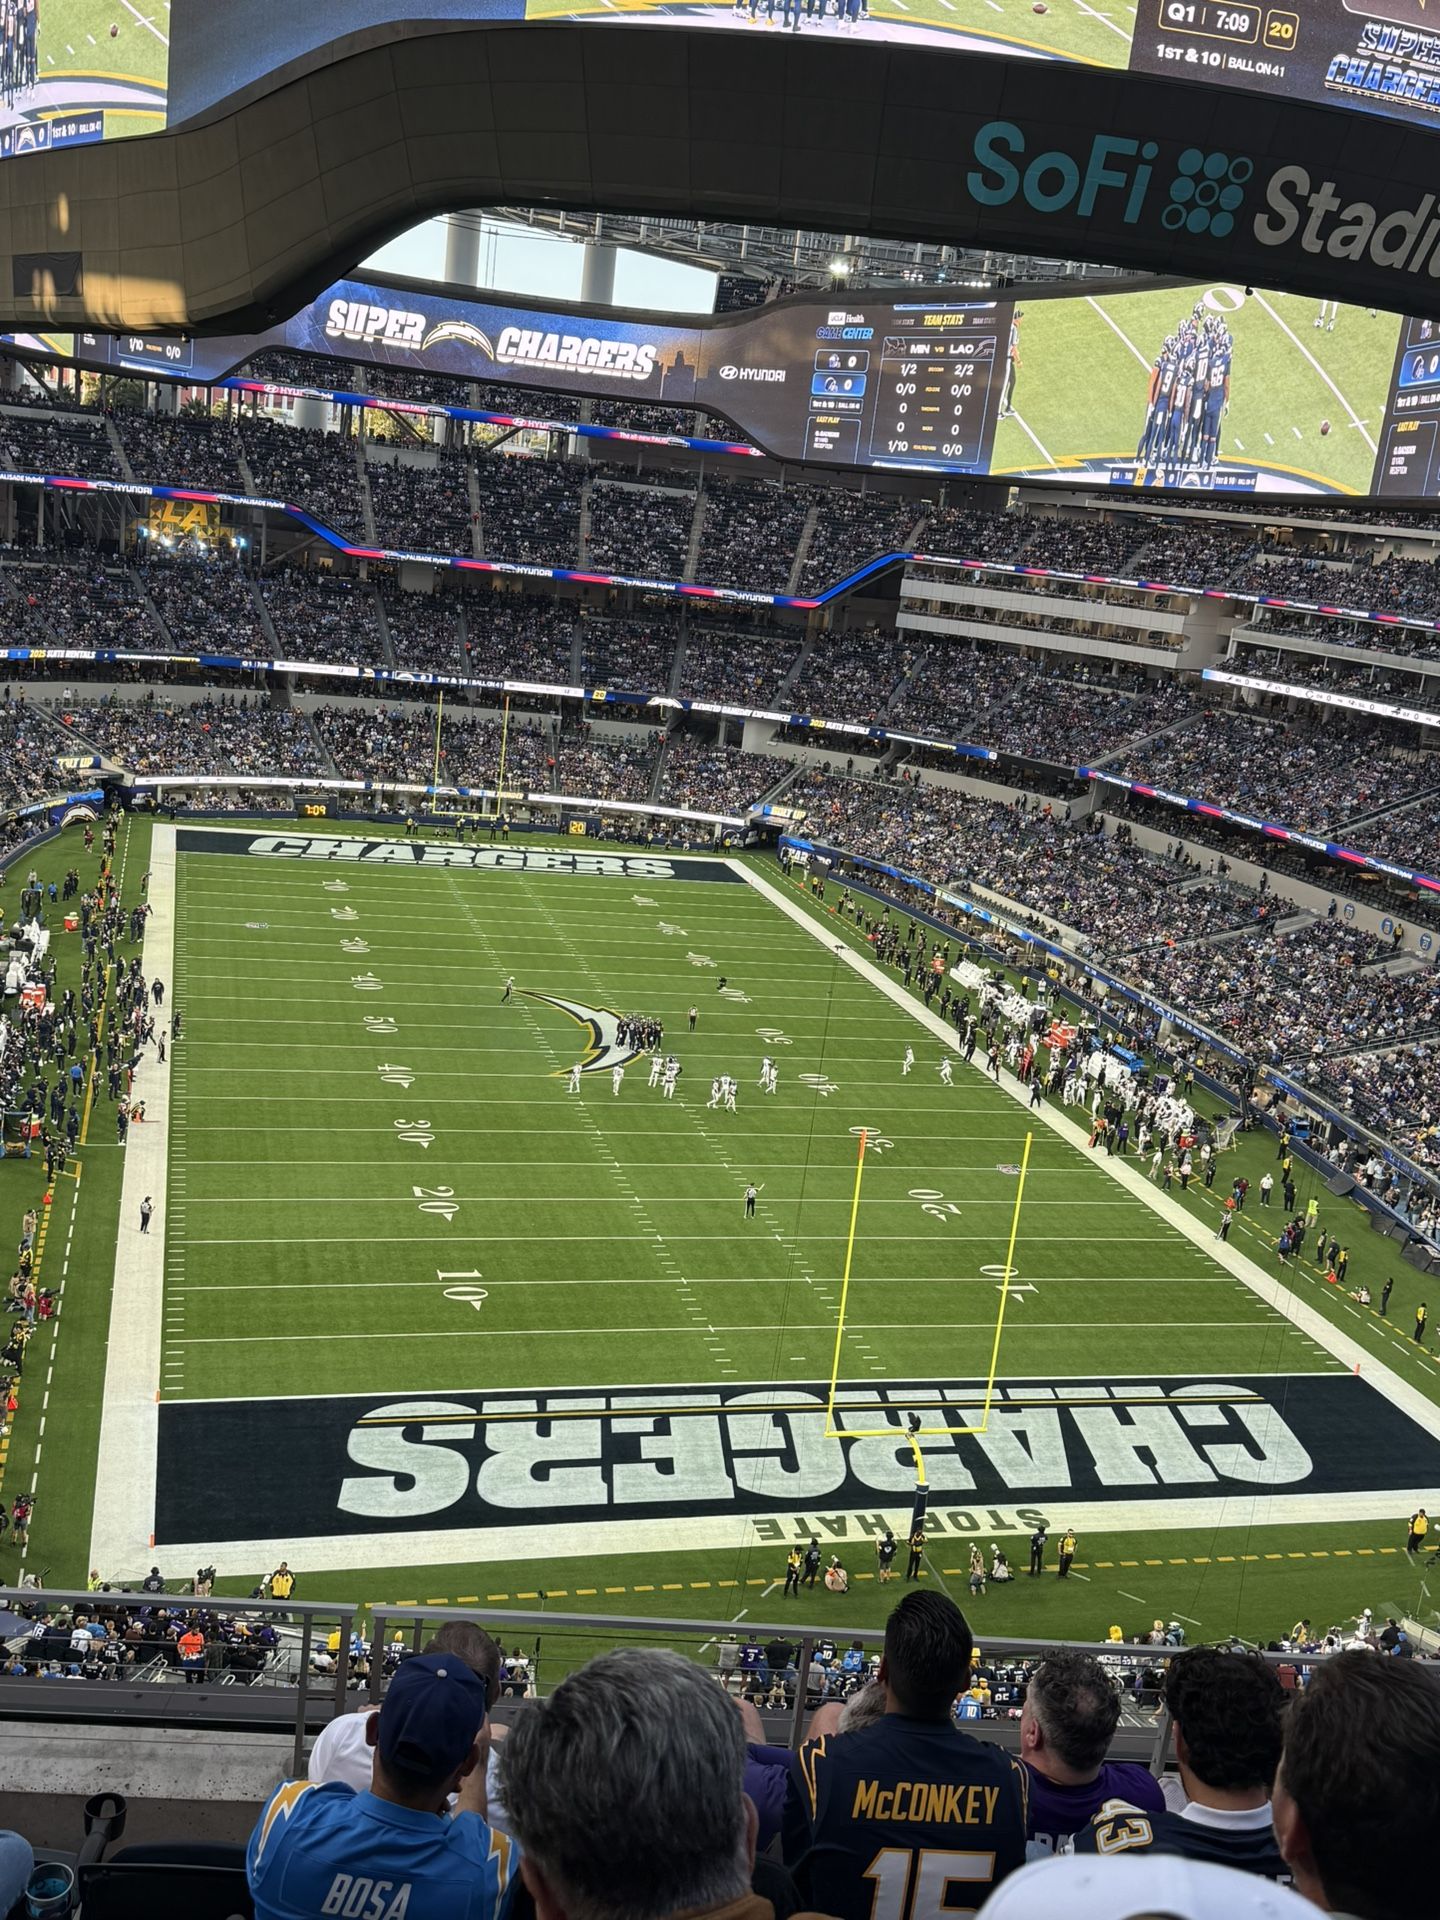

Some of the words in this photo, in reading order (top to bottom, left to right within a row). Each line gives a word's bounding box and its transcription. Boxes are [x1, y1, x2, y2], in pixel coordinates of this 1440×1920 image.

[1167, 3, 1196, 23] Q1
[1216, 10, 1250, 33] 7:09
[1268, 21, 1293, 39] 20
[1156, 44, 1184, 60] 1ST
[1184, 48, 1199, 63] &
[1201, 51, 1221, 66] 10
[1228, 56, 1255, 72] BALL
[1255, 62, 1272, 75] ON
[1271, 65, 1286, 78] 41
[967, 121, 1159, 225] SoFi
[325, 299, 436, 350] SUPER
[846, 314, 865, 323] Health
[923, 314, 943, 326] TEAM
[943, 313, 965, 326] STATS
[816, 326, 842, 339] GAME
[842, 327, 874, 340] CENTER
[129, 337, 144, 352] 1/10
[165, 345, 182, 360] 0/0
[496, 327, 657, 381] CHARGERS
[910, 344, 931, 355] MIN
[848, 355, 857, 368] 0
[740, 367, 786, 383] HYUNDAI
[900, 363, 918, 377] 1/2
[954, 364, 974, 378] 2/2
[844, 379, 853, 391] 0
[1161, 371, 1174, 393] 9
[895, 383, 916, 396] 0/0
[950, 384, 972, 398] 0/0
[899, 402, 908, 414] 0
[953, 404, 963, 416] 0
[896, 421, 905, 433] 0
[950, 424, 960, 436] 0
[887, 440, 908, 453] 1/10
[942, 444, 963, 457] 0/0
[25, 476, 45, 484] Hybrid
[115, 483, 153, 495] HYUNDAI
[240, 497, 266, 506] PALISADE
[267, 501, 286, 509] Hybrid
[161, 500, 208, 534] LA
[406, 553, 433, 563] PALISADE
[516, 566, 554, 577] HYUNDAI
[738, 593, 775, 604] HYUNDAI
[29, 649, 46, 658] 2025
[47, 649, 65, 658] SUITE
[65, 650, 96, 659] RENTALS
[437, 675, 449, 684] 1ST
[472, 678, 487, 687] BALL
[594, 690, 605, 698] 20
[809, 718, 826, 729] 2025
[842, 724, 870, 735] RENTALS
[79, 757, 94, 768] UP
[304, 804, 326, 816] 7:09
[792, 810, 806, 821] UP
[570, 822, 585, 834] 20
[248, 836, 676, 879] CHARGERS
[340, 939, 371, 953] 30
[350, 975, 384, 990] 40
[363, 1016, 399, 1033] 50
[755, 1028, 794, 1045] 50
[377, 1063, 416, 1083] 40
[798, 1073, 840, 1091] 40
[394, 1118, 436, 1142] 30
[412, 1185, 460, 1213] 20
[908, 1188, 963, 1215] 20
[436, 1268, 489, 1301] 10
[979, 1264, 1040, 1294] 10
[337, 1383, 1314, 1519] CHARGERS
[751, 1513, 892, 1541] HATE
[922, 1508, 1051, 1533] STOP
[747, 1652, 754, 1663] 3
[822, 1649, 833, 1661] 10
[967, 1705, 977, 1718] 10
[852, 1779, 1000, 1825] McCONKEY
[321, 1872, 412, 1920] BOSA
